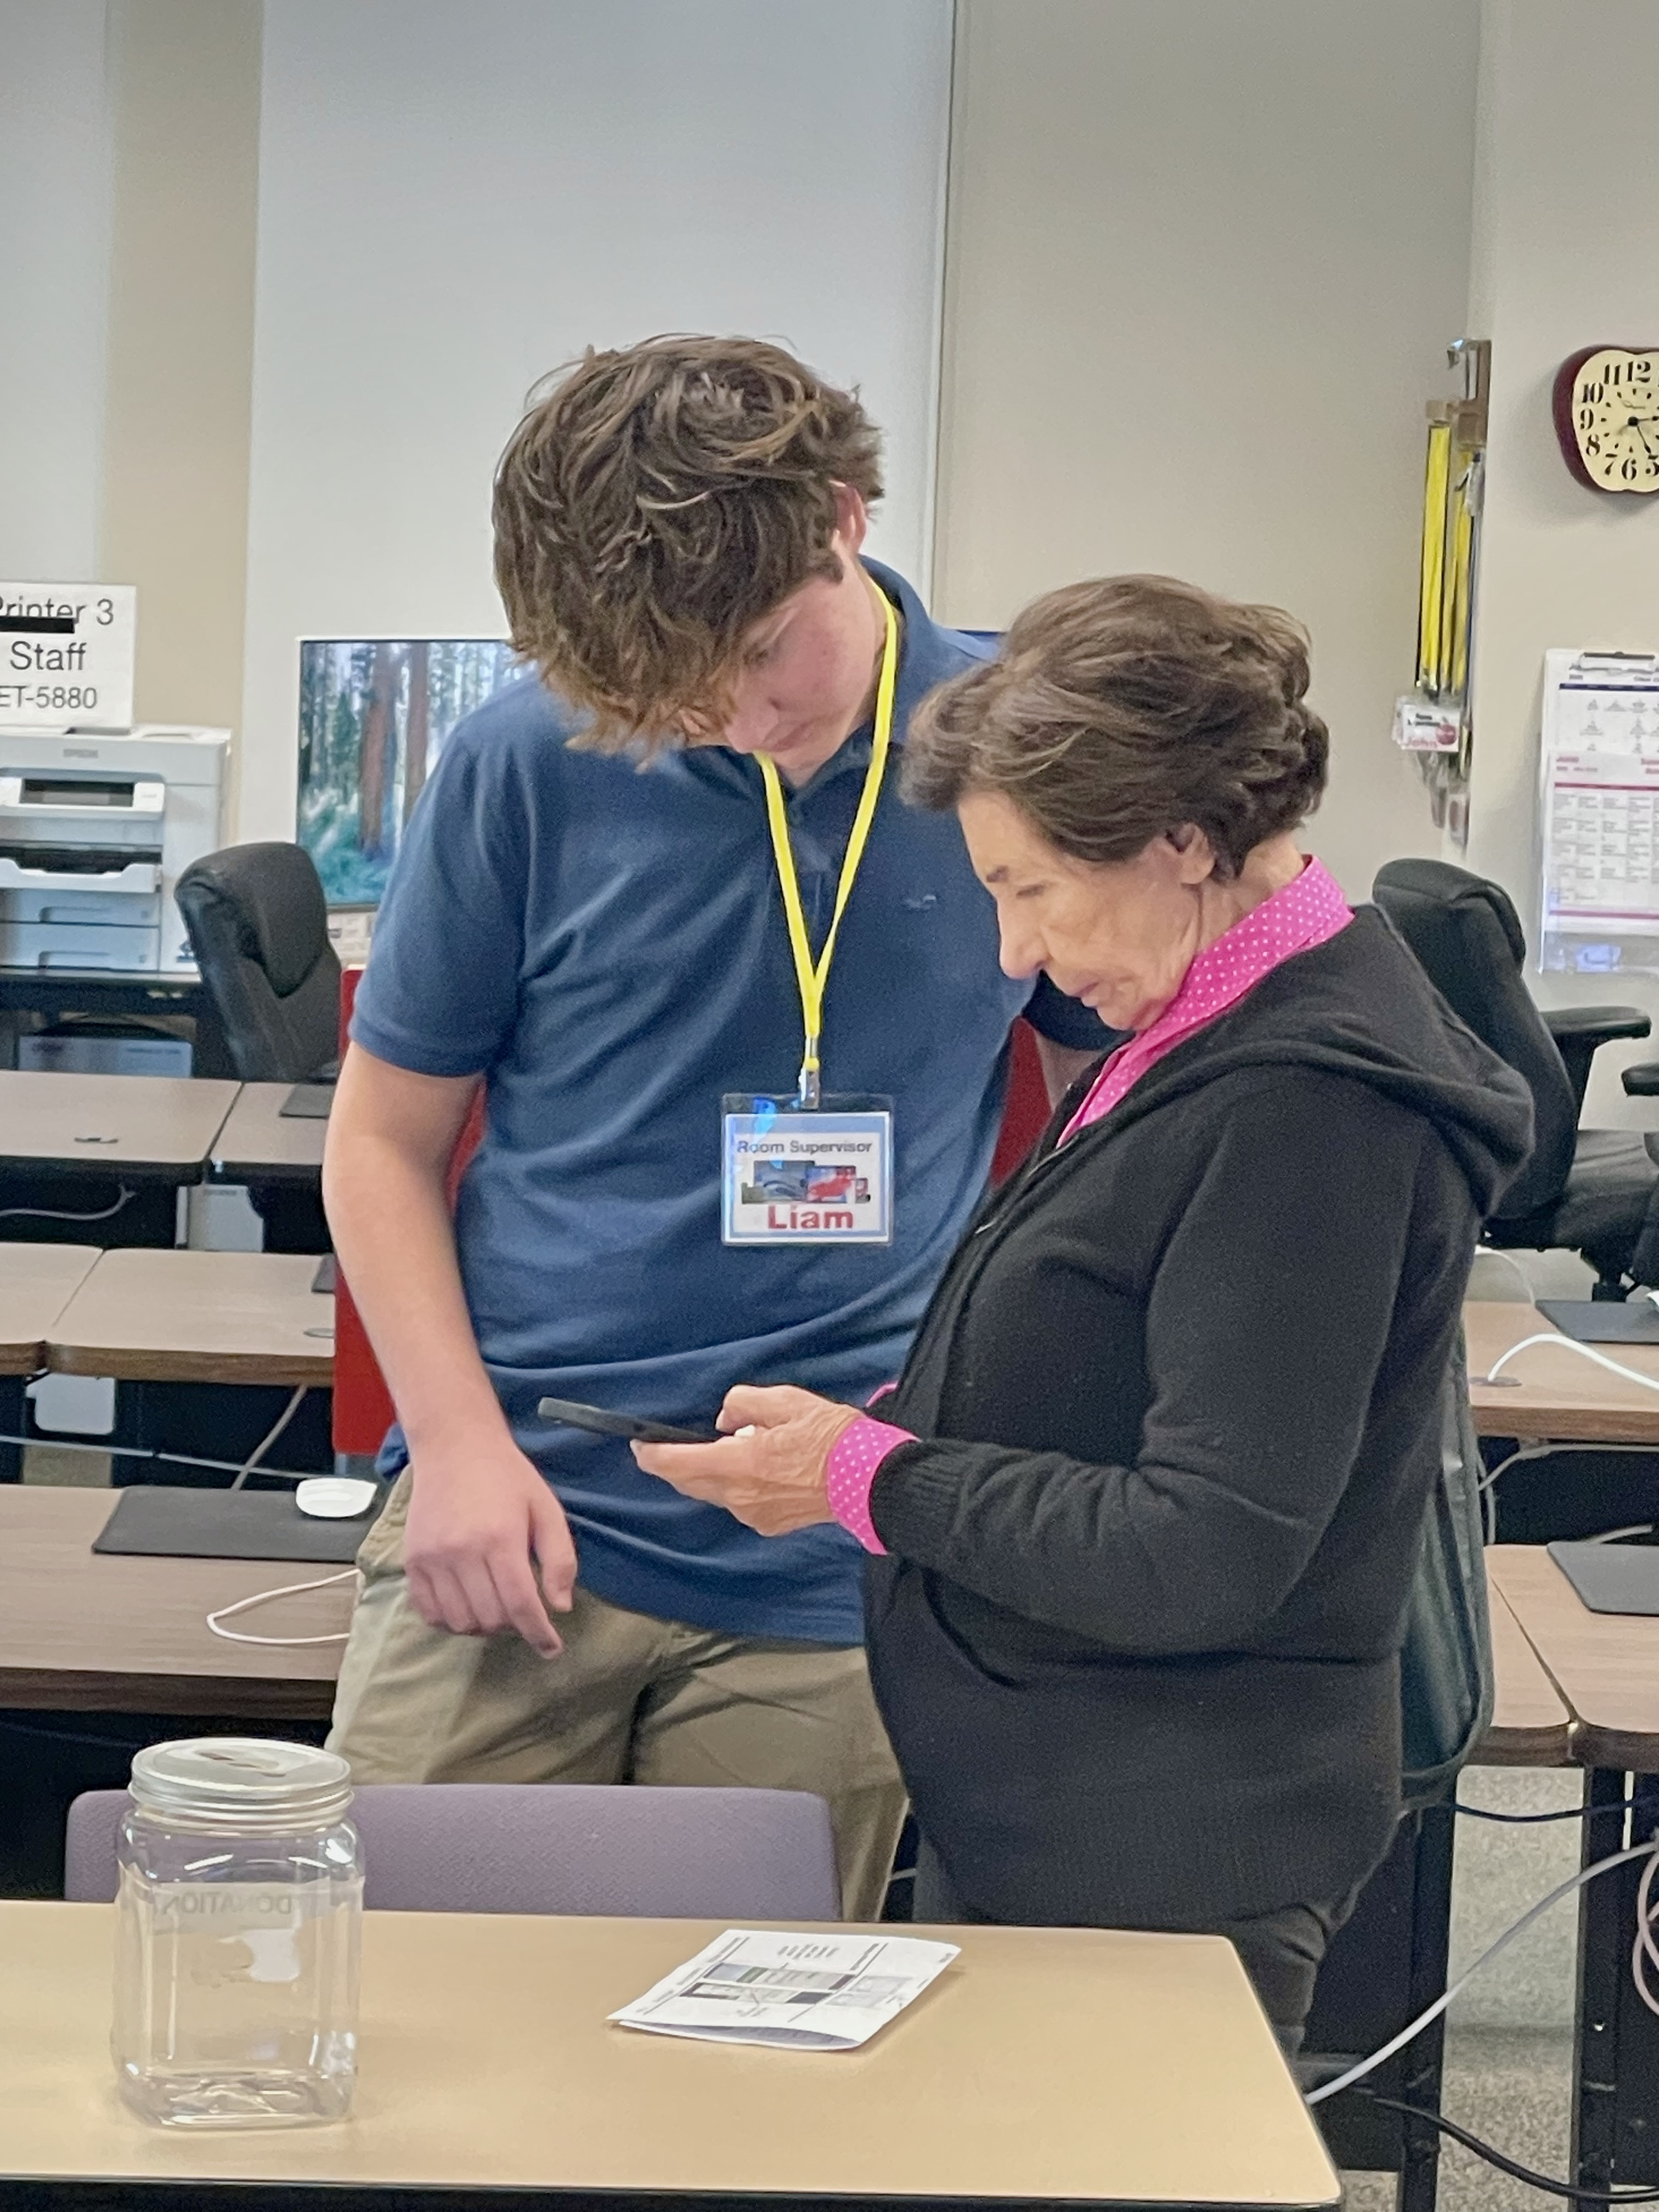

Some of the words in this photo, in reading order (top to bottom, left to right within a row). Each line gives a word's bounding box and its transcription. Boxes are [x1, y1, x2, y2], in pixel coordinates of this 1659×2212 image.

[1603, 364, 1621, 385] 11
[1627, 361, 1651, 383] 12
[1582, 382, 1604, 404] 10
[1580, 409, 1594, 430] 9
[1585, 434, 1601, 456] 8
[1604, 453, 1618, 476] 7
[1621, 458, 1637, 481] 6
[1645, 455, 1659, 477] 5
[0, 595, 87, 624] rinter
[96, 599, 114, 625] 3
[10, 641, 87, 670] Staff
[737, 1140, 785, 1153] Room
[789, 1140, 873, 1155] Supervisor
[768, 1205, 854, 1229] Liam
